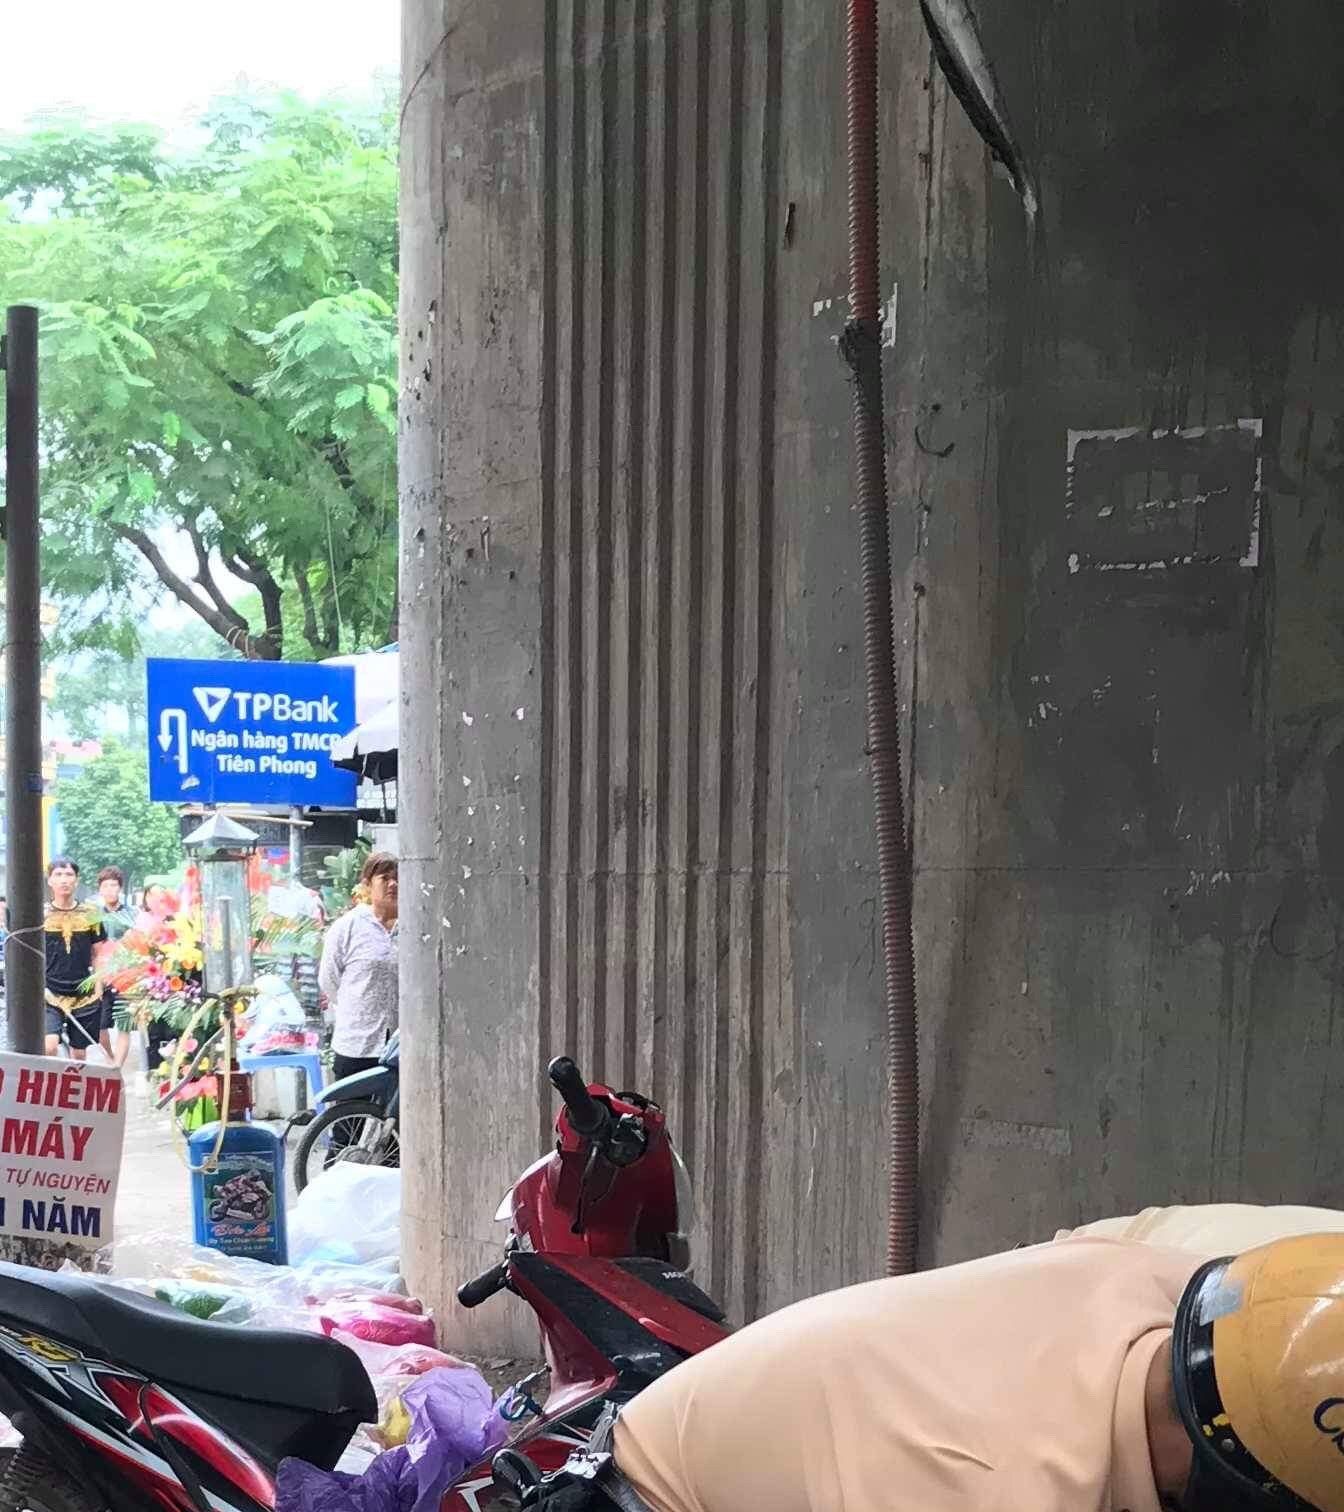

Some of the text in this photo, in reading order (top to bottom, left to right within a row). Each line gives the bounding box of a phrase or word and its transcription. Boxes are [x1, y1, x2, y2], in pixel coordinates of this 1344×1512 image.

[233, 691, 339, 723] TPBank
[191, 729, 239, 754] Ngân
[242, 729, 289, 754] hàng
[217, 755, 317, 778] Tiên Phong
[1, 1116, 95, 1161] MÁY
[6, 1167, 31, 1188] TỰ
[33, 1171, 111, 1197] NGUYỆN
[22, 1196, 102, 1238] NĂM
